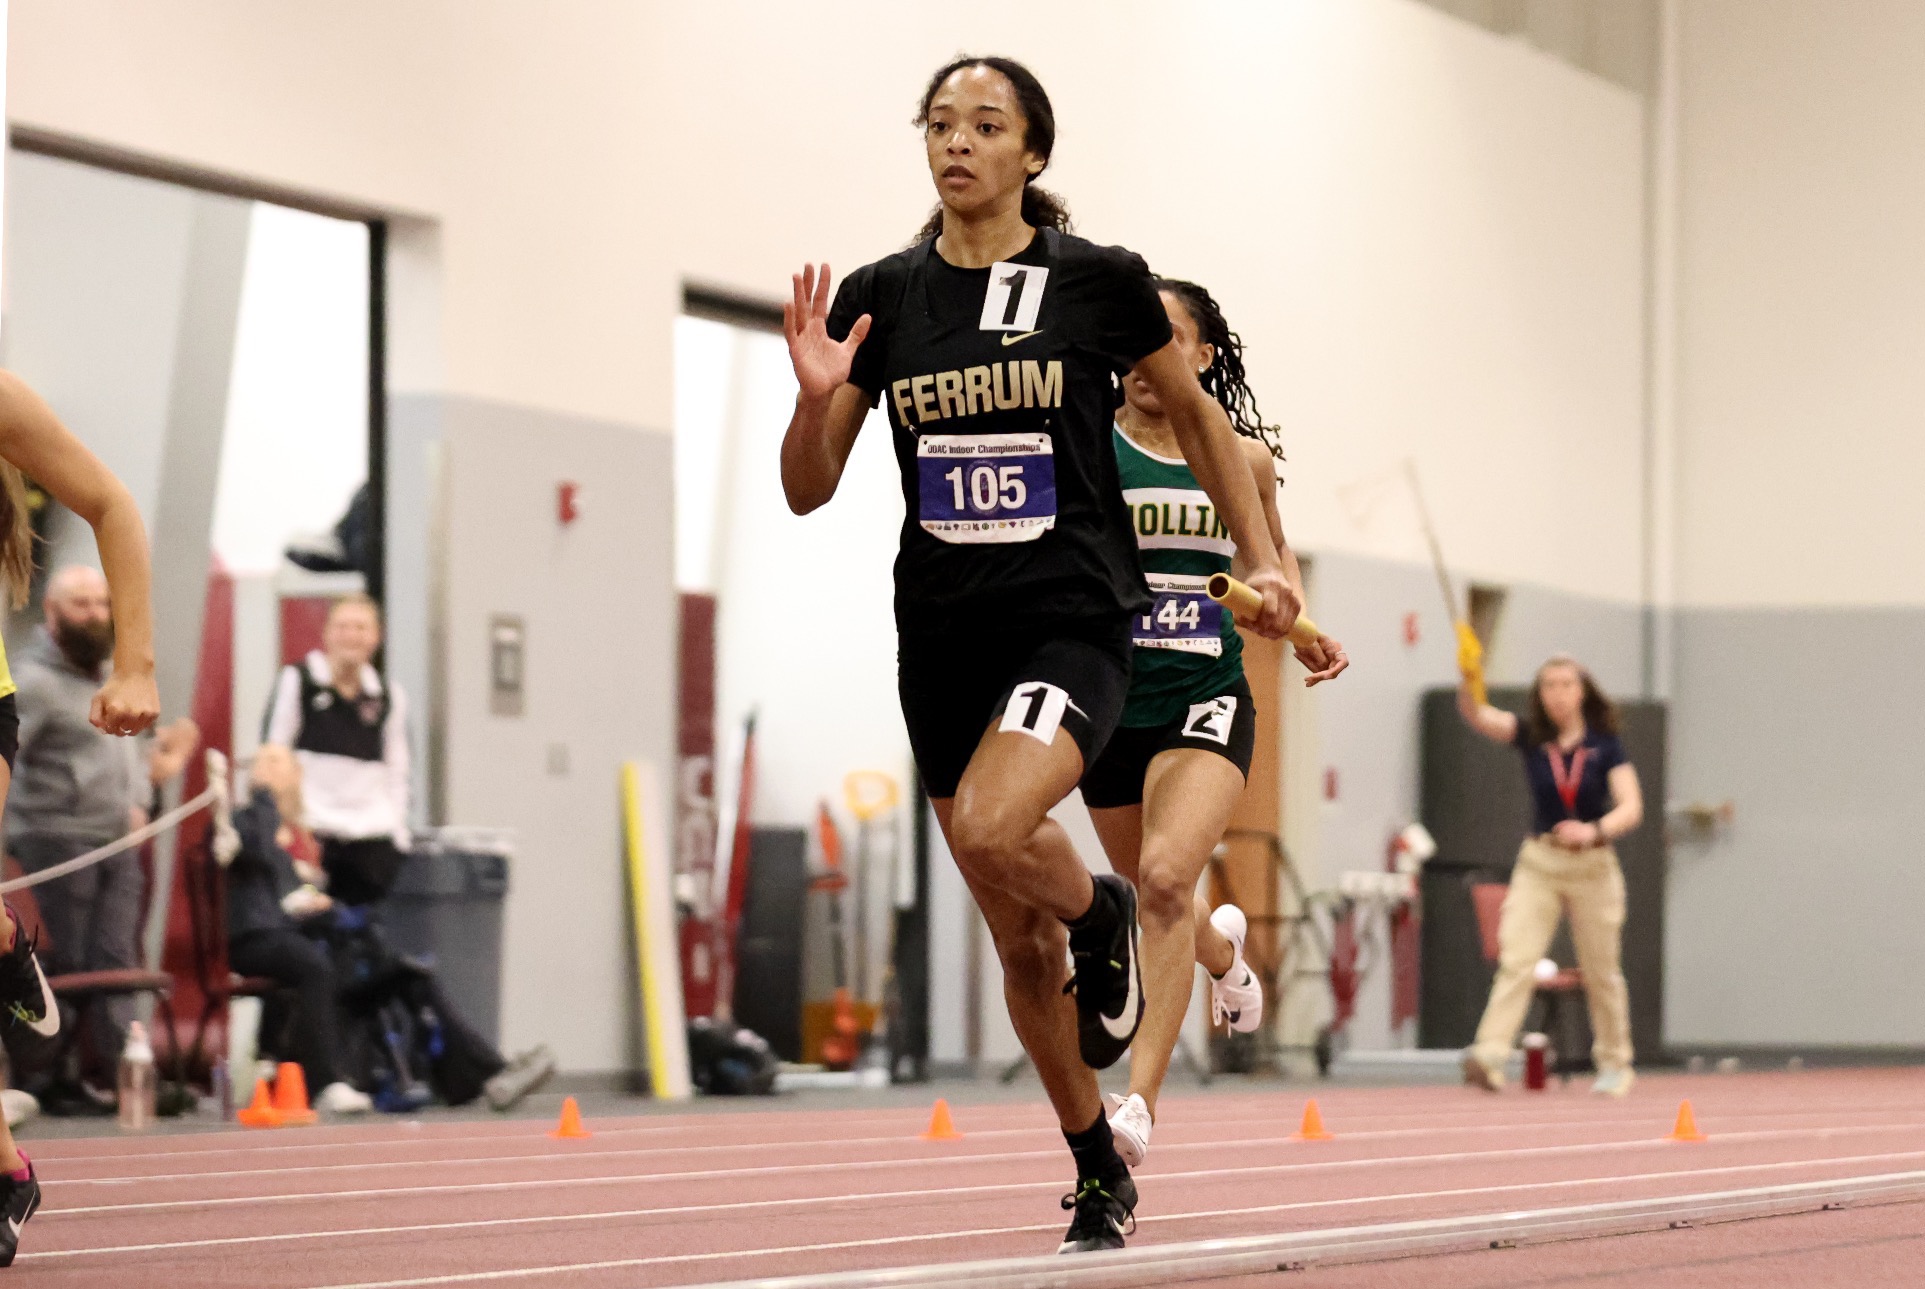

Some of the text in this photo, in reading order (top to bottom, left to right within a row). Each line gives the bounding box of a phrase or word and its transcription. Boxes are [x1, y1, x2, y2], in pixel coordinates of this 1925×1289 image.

[999, 270, 1027, 325] 1
[892, 359, 1063, 427] FERRUM
[949, 446, 975, 454] Indoor
[977, 444, 1041, 454] Championships
[945, 465, 1027, 511] 105
[1020, 686, 1048, 731] 1
[1190, 699, 1228, 737] 2
